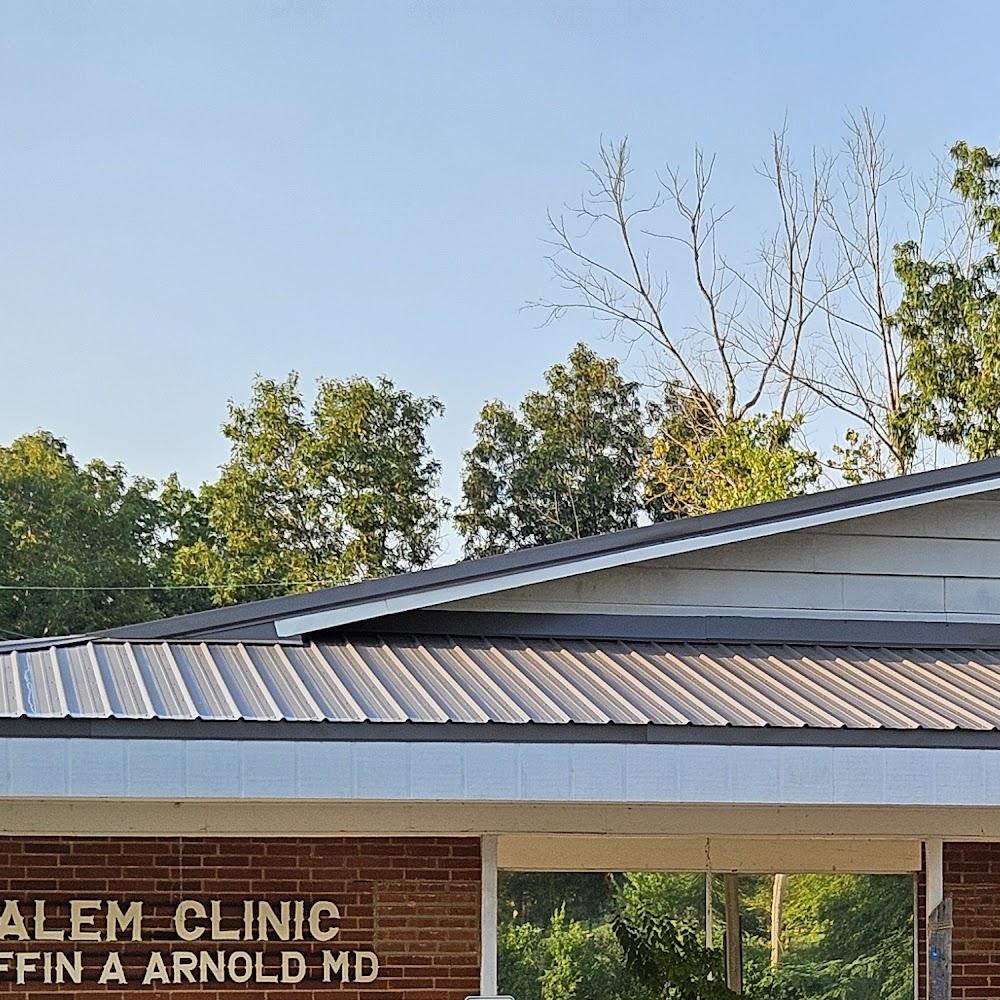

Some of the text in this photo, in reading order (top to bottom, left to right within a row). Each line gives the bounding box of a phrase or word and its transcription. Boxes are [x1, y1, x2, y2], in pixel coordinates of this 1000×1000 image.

[0, 900, 342, 942] ALEM CLINIC
[97, 951, 128, 985] A
[141, 951, 308, 985] ARNOLD
[321, 950, 380, 984] MD
